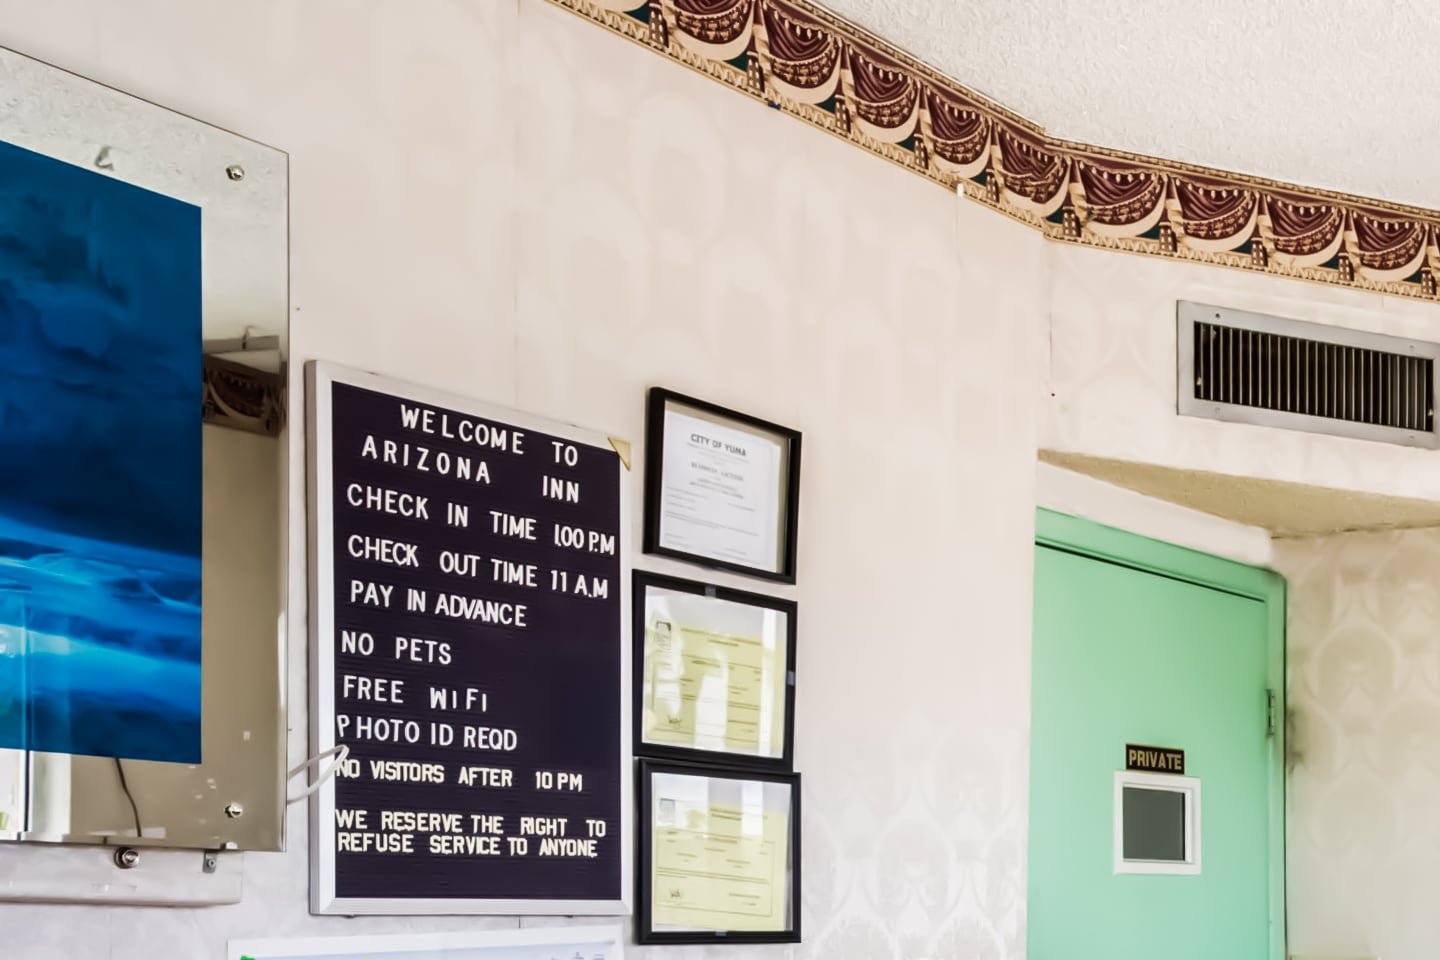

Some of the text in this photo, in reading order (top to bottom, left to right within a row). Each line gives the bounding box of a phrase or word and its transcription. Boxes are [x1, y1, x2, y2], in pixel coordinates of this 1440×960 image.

[401, 404, 578, 467] WELCOME TO
[690, 433, 710, 445] CITY
[712, 439, 722, 449] OF
[724, 443, 747, 456] YUMA
[361, 435, 579, 503] ARIZONA INN
[347, 483, 429, 520] CHECK
[447, 503, 468, 527] IN
[490, 511, 536, 540] TIME
[588, 530, 615, 555] P.M
[348, 535, 608, 599] CHECK OUT TIME 11 A.M
[351, 580, 527, 626] PAY IN ADVANCE
[341, 631, 451, 664] NO PETS
[343, 674, 404, 704] FREE
[337, 714, 517, 751] PHOTO ID REQD
[336, 759, 582, 792] NO VISITORS AFTER 10 PM
[1128, 748, 1182, 770] PRIVATE
[335, 808, 606, 837] WE RESERVE THE RIGHT TO
[338, 832, 598, 858] REFUSE SERVICE TO ANYONE
